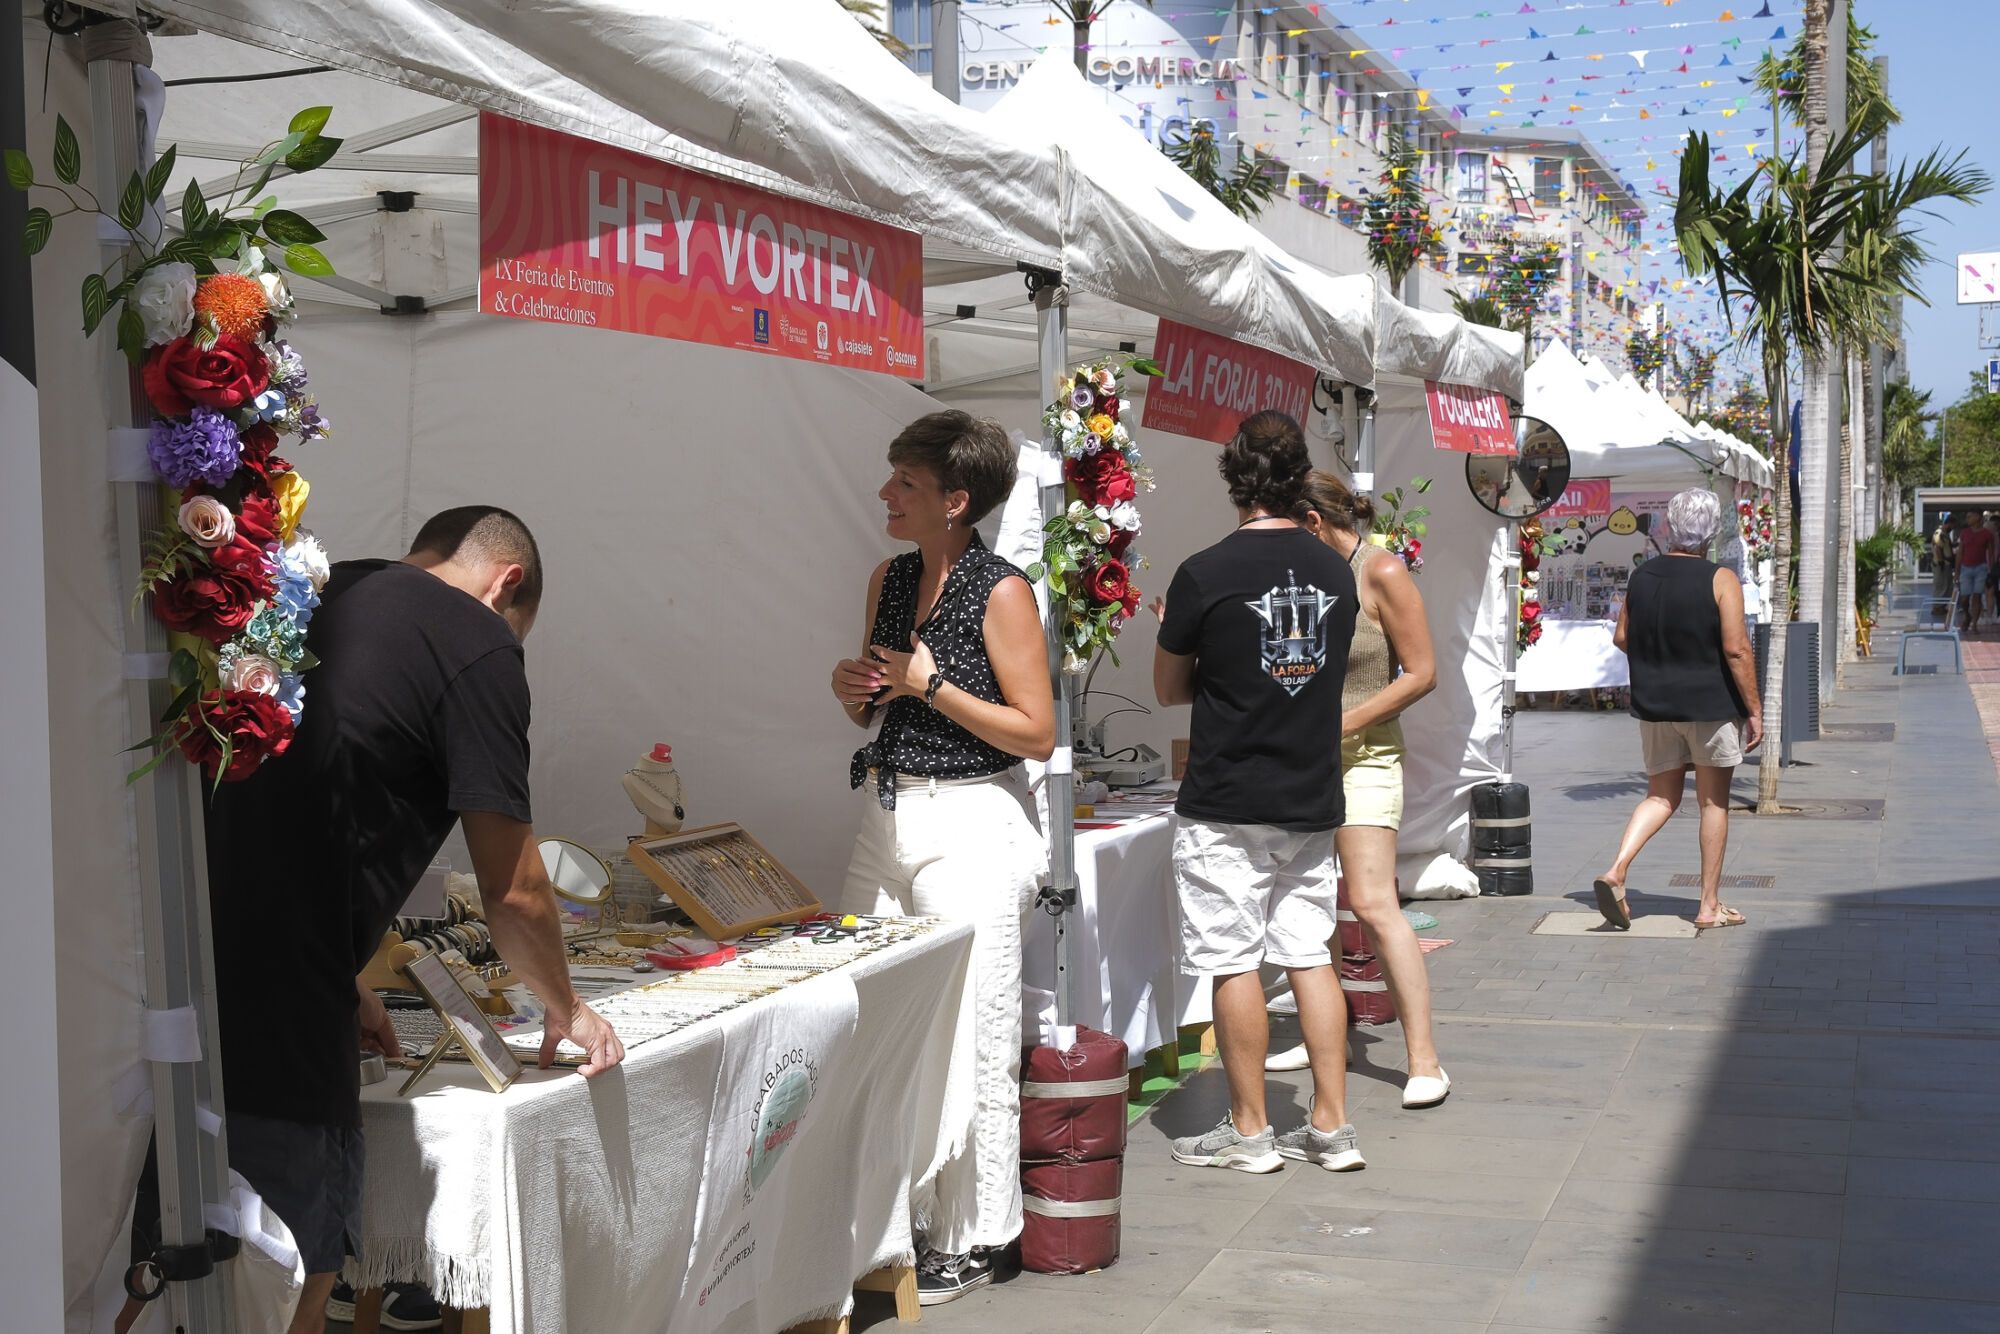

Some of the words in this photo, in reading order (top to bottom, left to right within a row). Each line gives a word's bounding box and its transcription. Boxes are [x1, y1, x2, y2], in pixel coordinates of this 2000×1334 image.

[962, 59, 1037, 82] CENT
[1088, 56, 1236, 80] COMERCIA
[588, 170, 702, 276] HEY
[714, 202, 877, 317] VORTEX
[495, 258, 513, 280] IX
[516, 260, 548, 286] Feria
[551, 267, 566, 289] de
[568, 269, 615, 297] Eventos
[495, 290, 509, 313] &
[511, 292, 597, 326] Celebraciones
[845, 338, 873, 356] cajasiete
[1161, 343, 1194, 398] LA
[1201, 354, 1260, 413] FORJA
[1272, 666, 1286, 676] LA
[1287, 664, 1316, 676] FORJA
[1282, 677, 1292, 686] 3D
[1292, 676, 1306, 685] LAB
